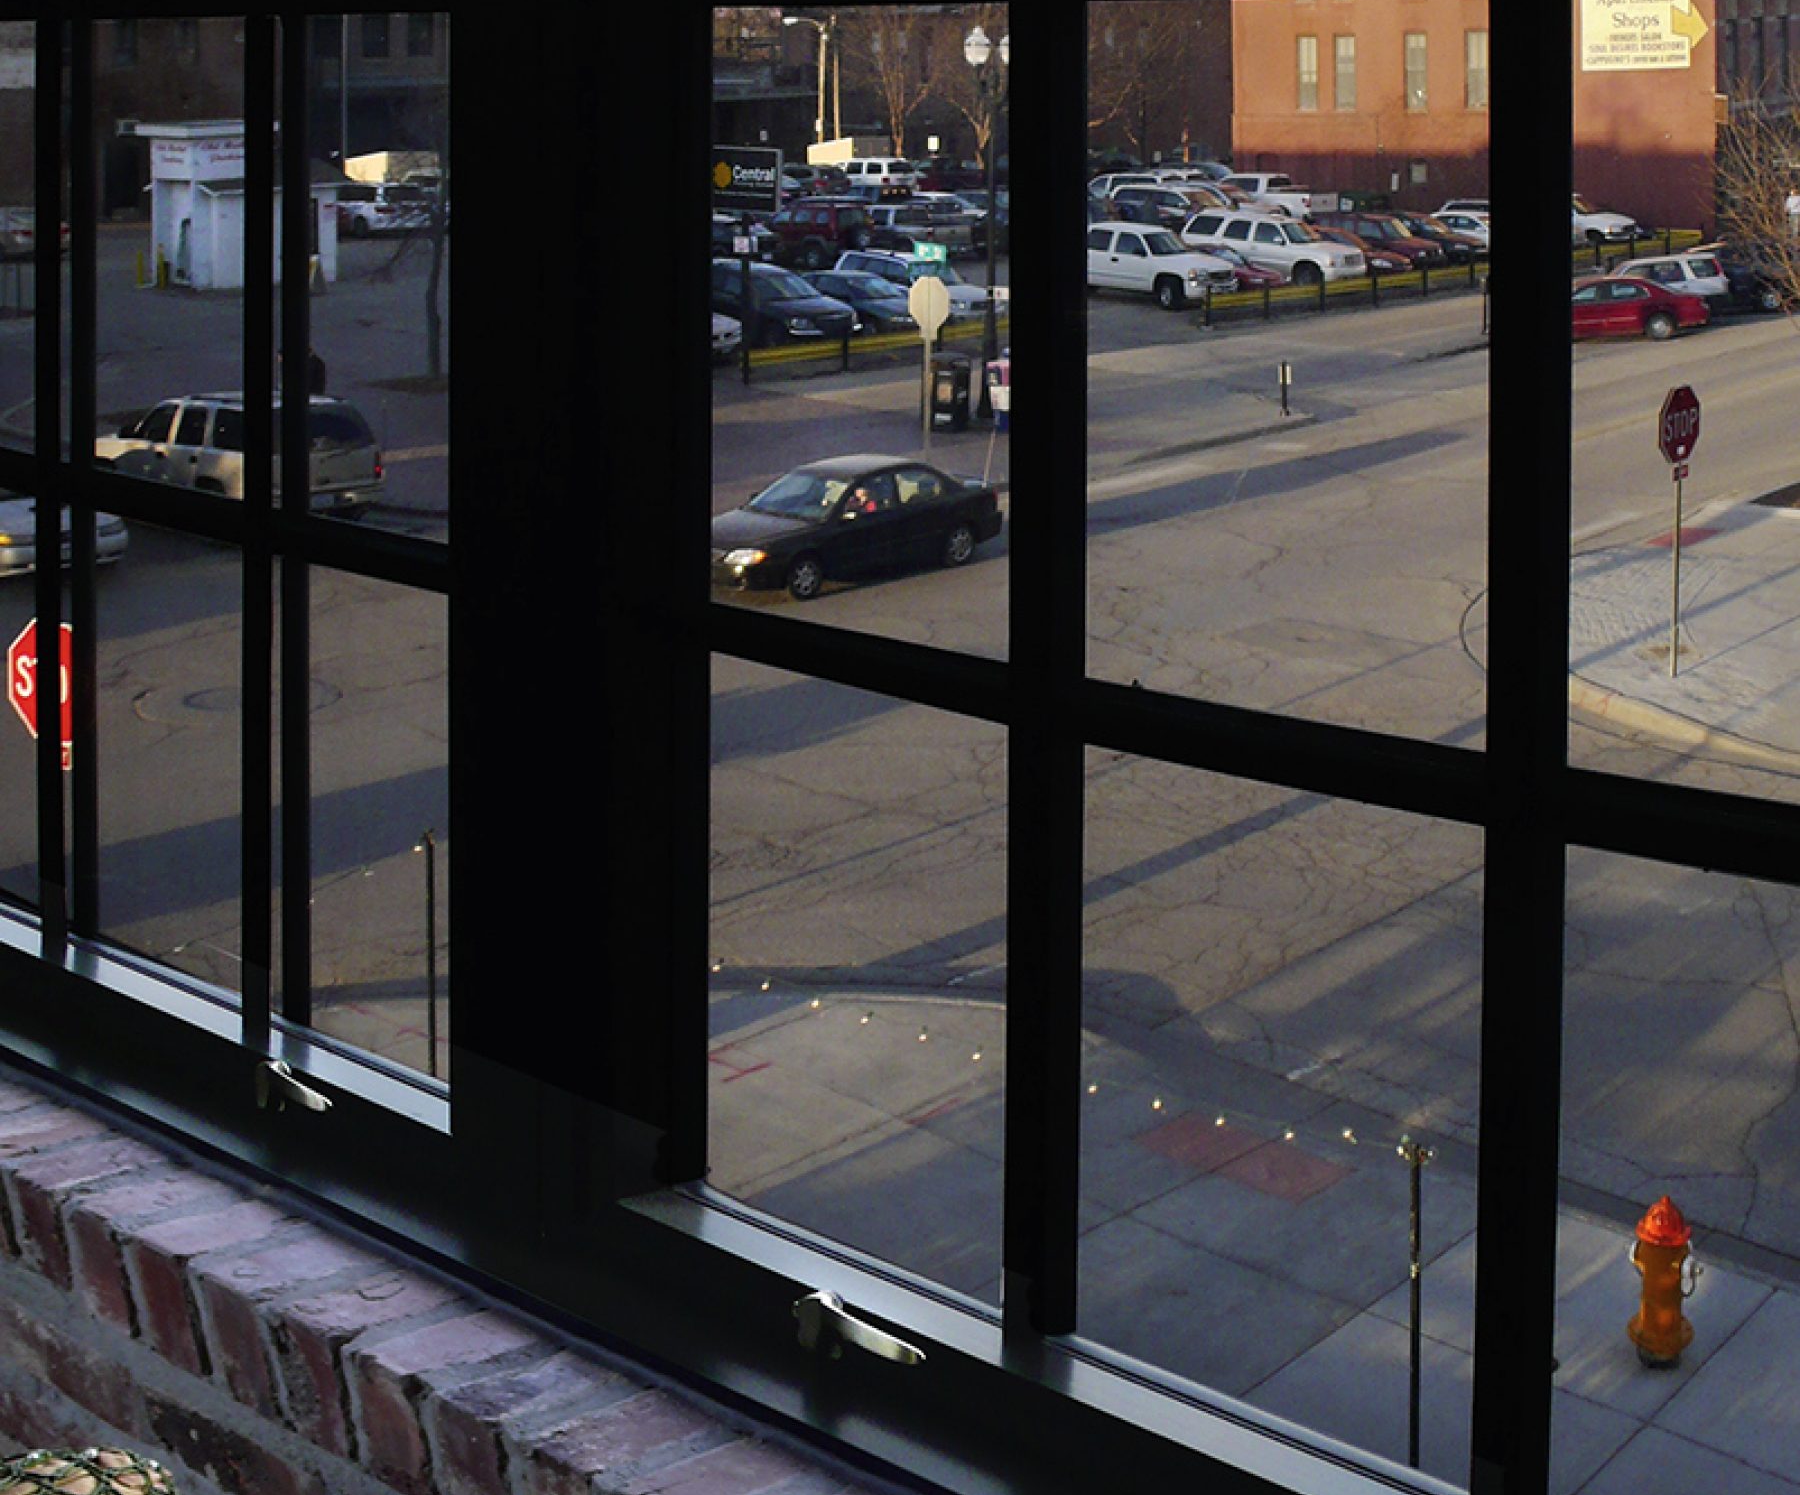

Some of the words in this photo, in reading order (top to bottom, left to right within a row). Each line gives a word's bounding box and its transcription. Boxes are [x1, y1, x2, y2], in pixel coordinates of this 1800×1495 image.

[1612, 11, 1660, 31] Shops
[732, 164, 777, 182] Central
[1665, 408, 1699, 443] STOP
